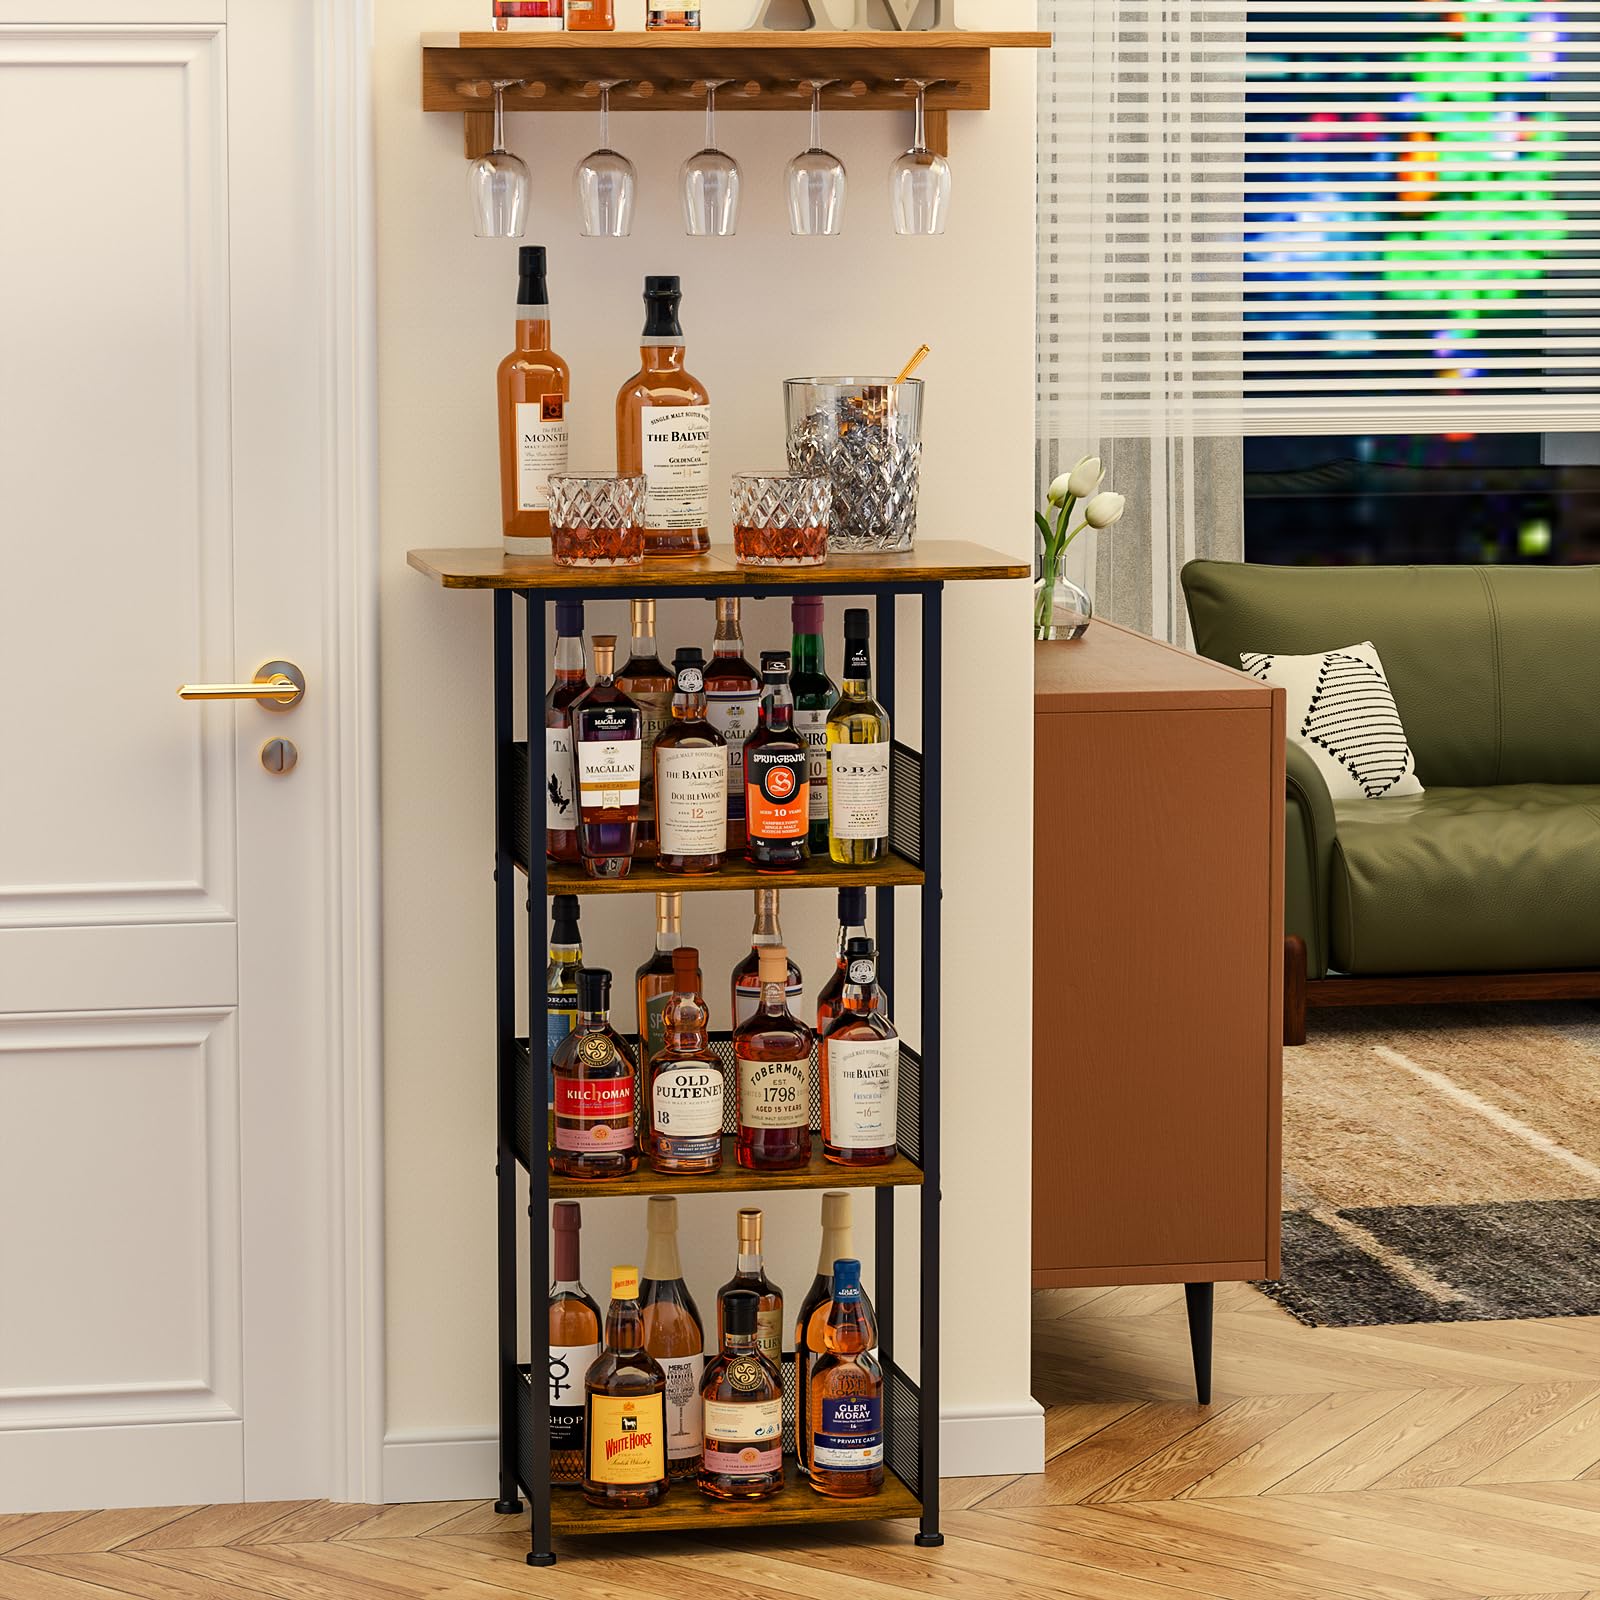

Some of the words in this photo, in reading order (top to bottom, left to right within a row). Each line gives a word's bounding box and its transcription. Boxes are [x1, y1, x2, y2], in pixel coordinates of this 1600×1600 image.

[646, 434, 669, 442] THE
[729, 751, 742, 766] 12
[753, 753, 806, 764] SPRINGBANK
[586, 764, 635, 774] MACALLAN
[836, 765, 889, 774] OBAN
[691, 808, 704, 819] 12
[774, 808, 787, 817] 10
[750, 1063, 806, 1087] TOBERMORY
[842, 1070, 855, 1079] THE
[856, 1069, 890, 1079] BALVENIE
[675, 1075, 710, 1087] OLD
[656, 1084, 723, 1099] PULTENEY
[764, 1086, 796, 1103] 1798
[756, 1105, 773, 1113] AGED
[774, 1105, 782, 1113] 15
[784, 1103, 802, 1112] YEARS
[657, 1110, 670, 1124] 18
[668, 1363, 691, 1371] MERLOT
[838, 1403, 867, 1412] GLEN
[834, 1411, 871, 1420] MORAY
[605, 1436, 629, 1461] WHITE
[629, 1432, 653, 1449] HORSE
